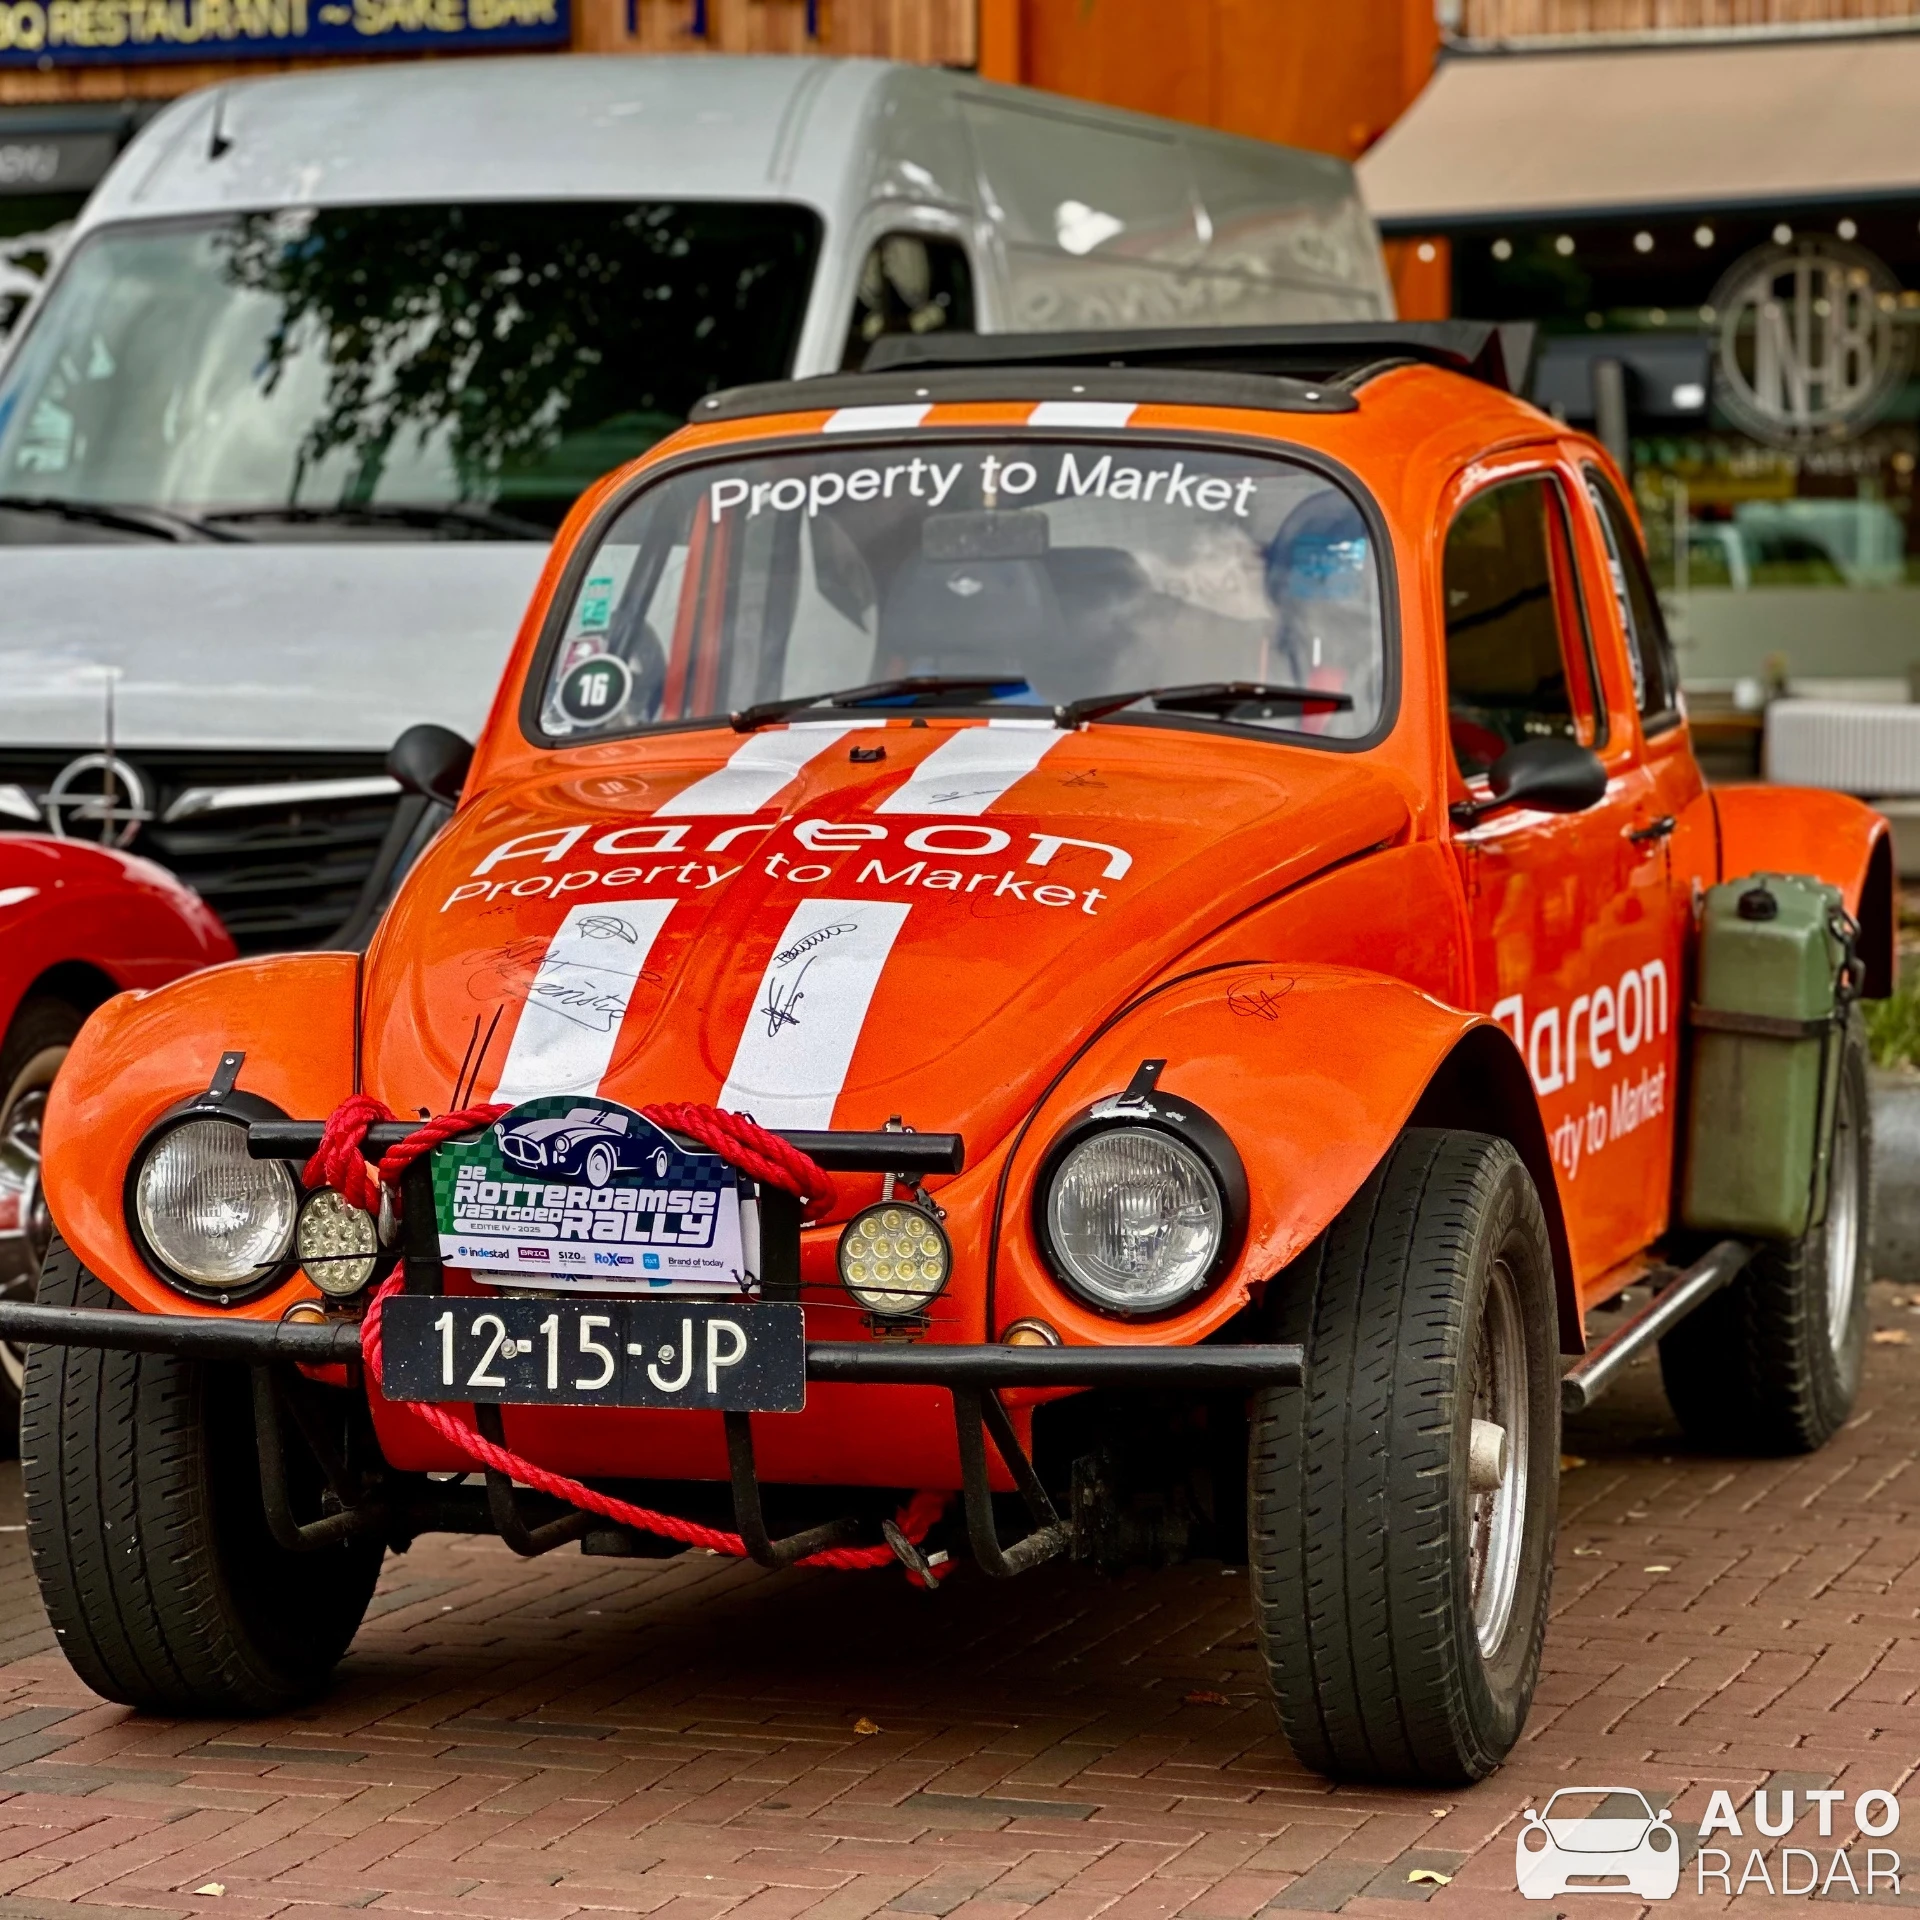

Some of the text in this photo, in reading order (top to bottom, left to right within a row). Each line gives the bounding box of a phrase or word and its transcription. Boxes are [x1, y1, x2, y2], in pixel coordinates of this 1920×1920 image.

[48, 0, 308, 47] RESTAURANT
[711, 453, 1258, 523] Property to Market
[578, 672, 610, 707] 16
[440, 852, 1107, 916] Property to Market
[1587, 1101, 1608, 1155] to
[1609, 1061, 1667, 1142] Market
[470, 1223, 500, 1233] EDITIE
[502, 1224, 511, 1233] IV
[518, 1225, 541, 1234] 2025
[469, 1247, 510, 1259] indestad
[668, 1257, 724, 1268] Brand of today
[434, 1311, 748, 1395] 12-15-JP
